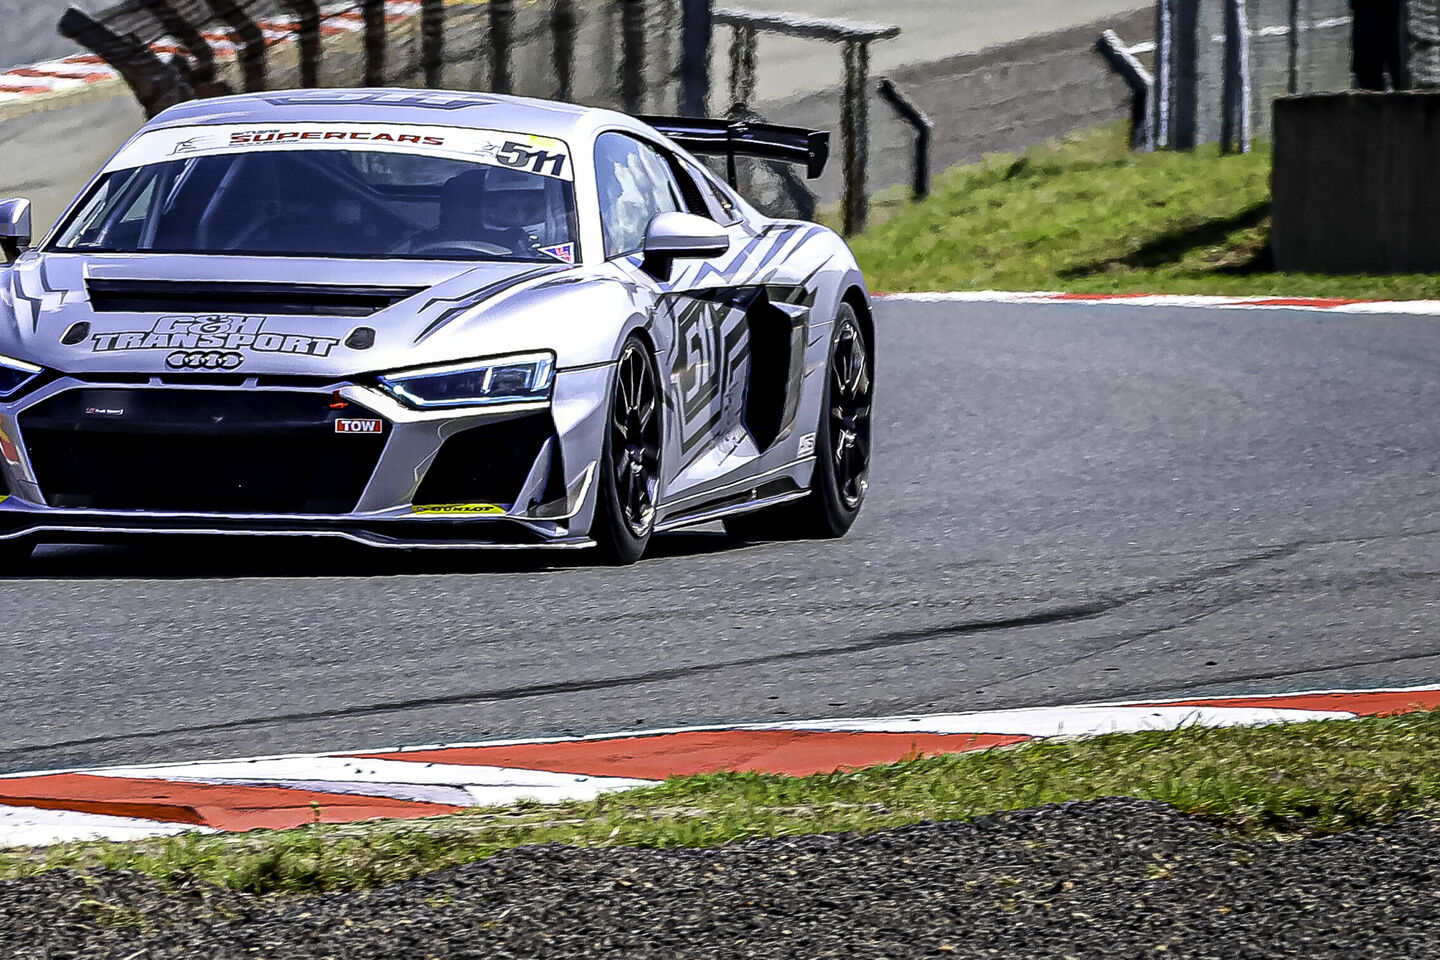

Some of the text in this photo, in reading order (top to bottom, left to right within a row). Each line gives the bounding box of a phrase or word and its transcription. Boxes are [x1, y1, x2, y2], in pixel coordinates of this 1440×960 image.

[229, 131, 445, 146] SUPERCARS
[496, 141, 566, 176] 511
[151, 314, 267, 335] G&H
[90, 332, 342, 357] TRANSPORT
[341, 421, 376, 432] TOW
